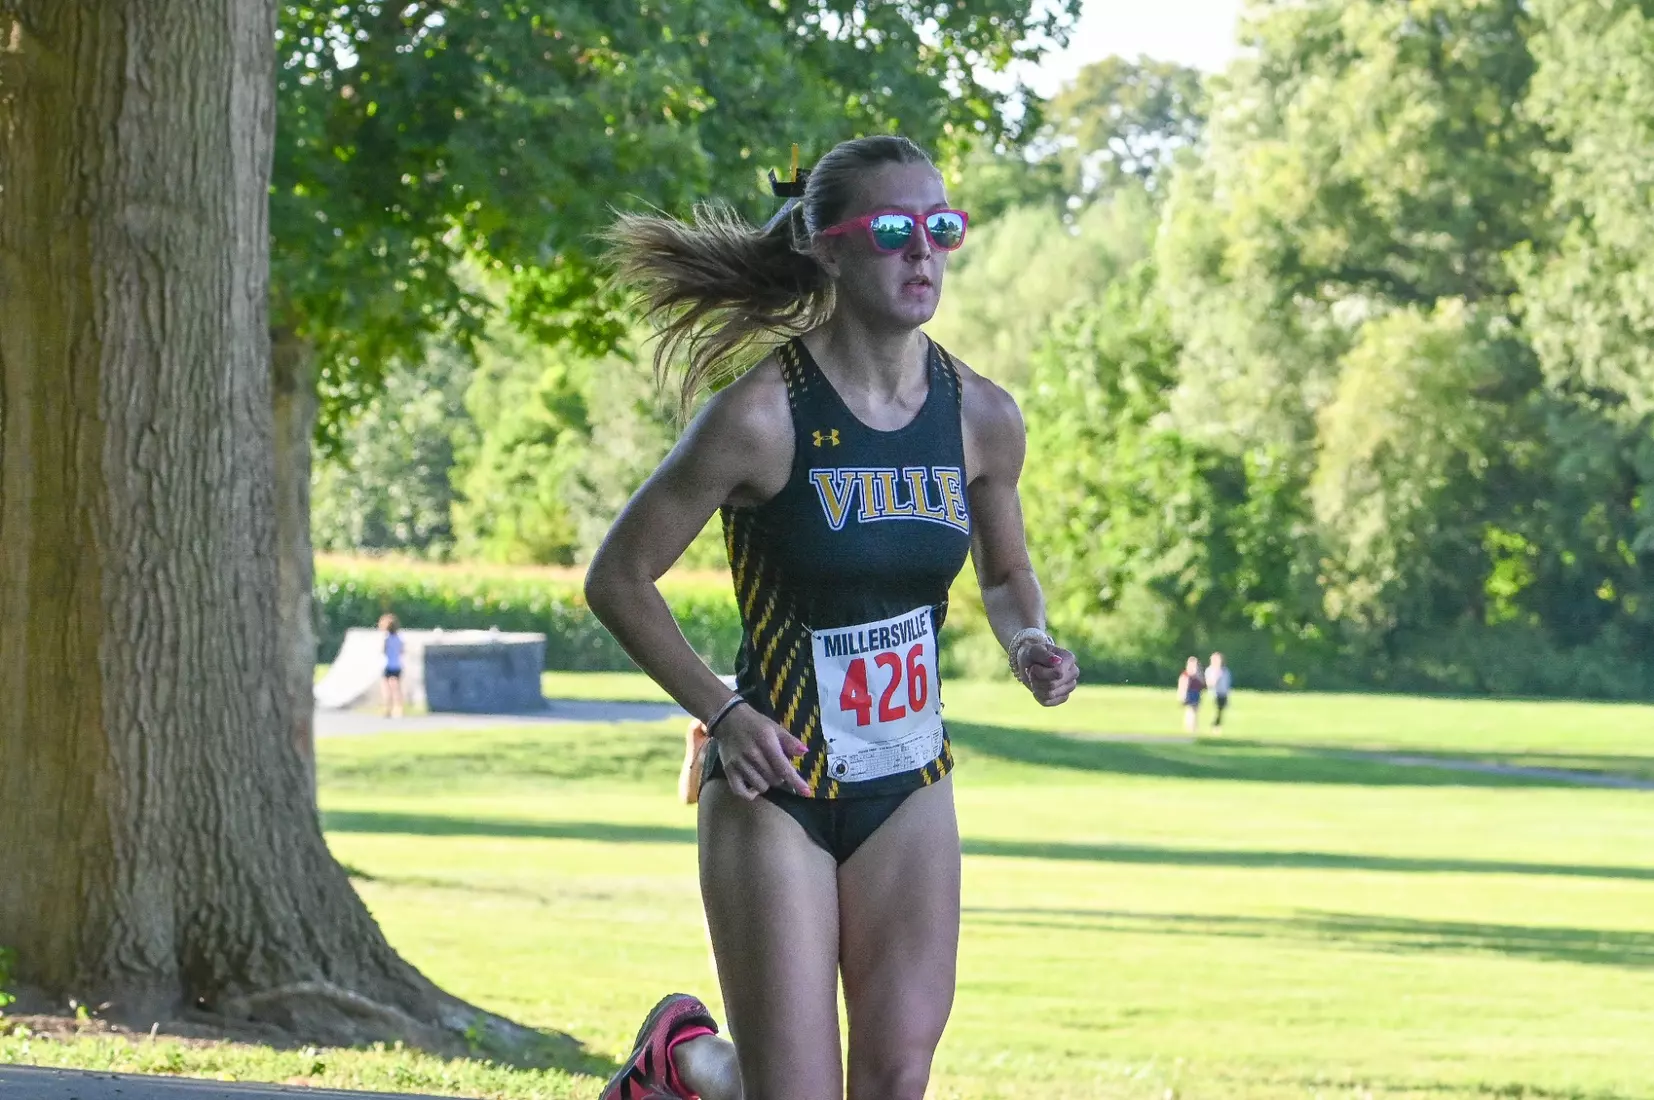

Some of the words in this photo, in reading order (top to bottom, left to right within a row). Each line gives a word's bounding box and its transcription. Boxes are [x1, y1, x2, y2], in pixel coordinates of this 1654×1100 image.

[809, 466, 970, 535] VILLE
[823, 613, 928, 657] MILLERSVILLE
[839, 643, 928, 726] 426
